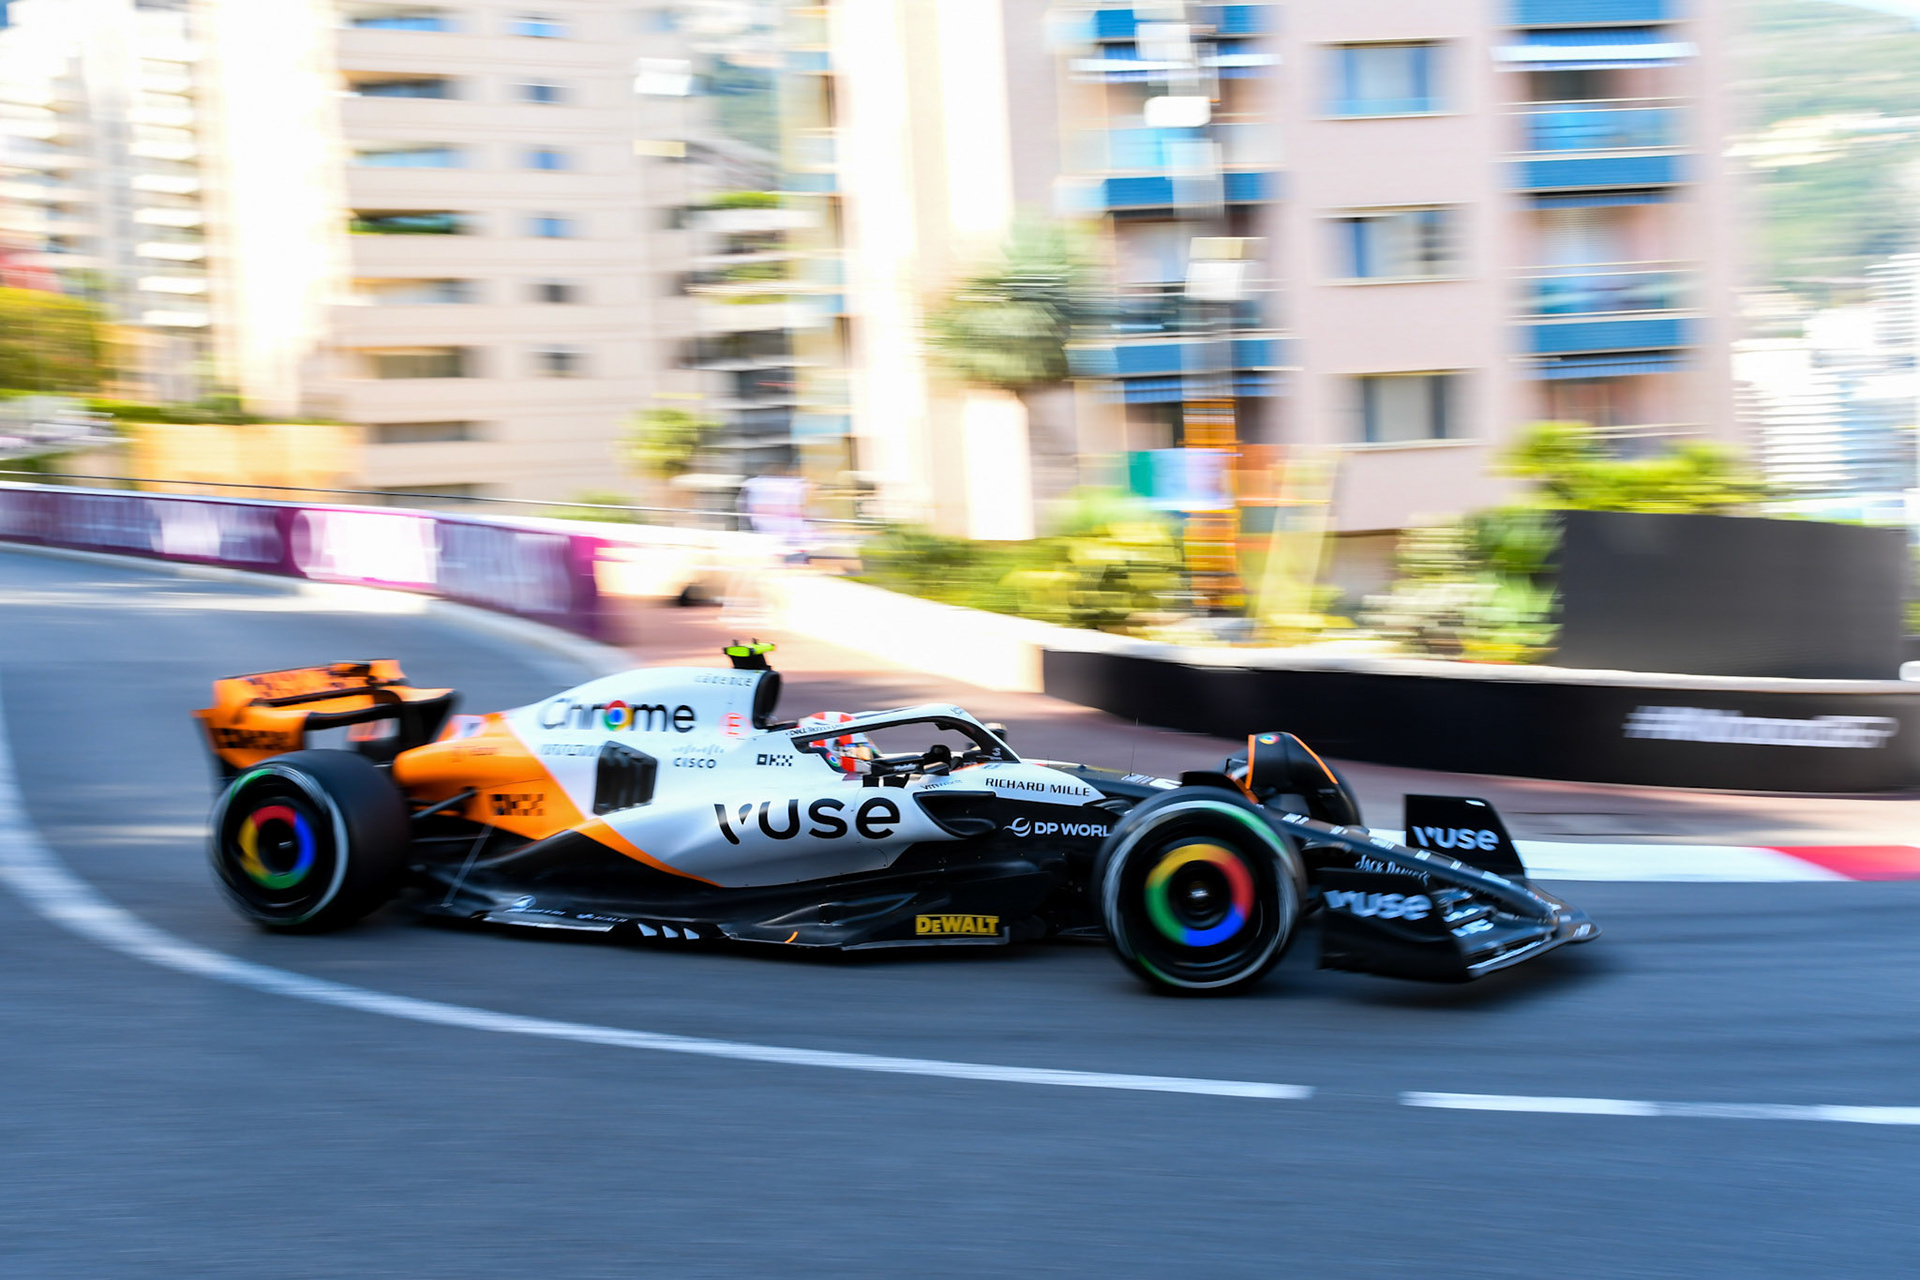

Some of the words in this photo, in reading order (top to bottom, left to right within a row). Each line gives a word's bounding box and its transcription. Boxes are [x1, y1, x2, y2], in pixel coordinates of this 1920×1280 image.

[757, 753, 793, 767] OKX
[985, 777, 1045, 792] RICHARD
[1050, 783, 1091, 797] MILLE
[1034, 821, 1059, 835] DP
[1060, 822, 1113, 838] WORL
